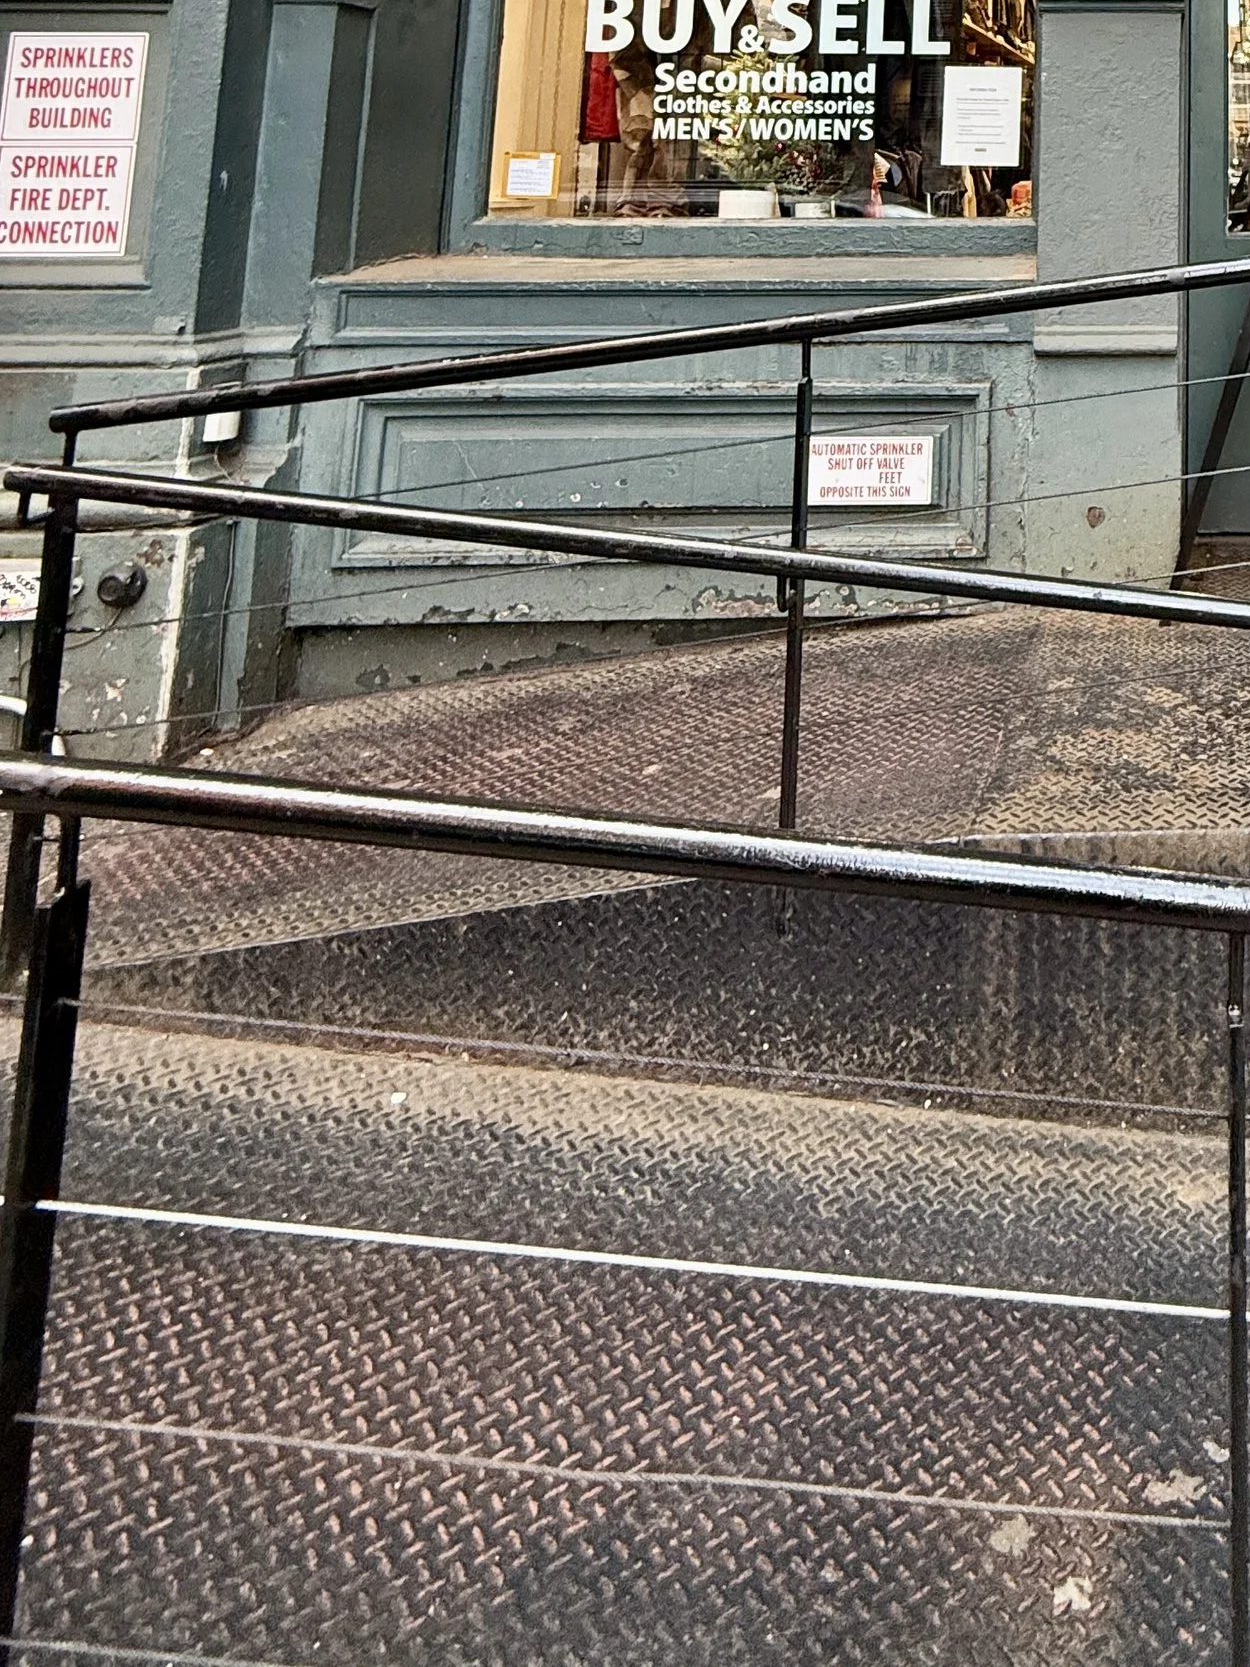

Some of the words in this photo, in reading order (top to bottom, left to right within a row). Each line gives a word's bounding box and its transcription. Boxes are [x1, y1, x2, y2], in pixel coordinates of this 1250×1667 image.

[738, 24, 765, 54] &
[20, 46, 135, 69] SPRINKLERS
[14, 77, 135, 99] THROUGHOUT
[654, 62, 877, 94] Secondhand
[653, 95, 732, 114] Clothes
[735, 95, 752, 114] &
[756, 95, 875, 114] Accessories
[28, 107, 112, 128] BUILDING
[10, 155, 118, 178] SPRINKLER
[9, 188, 53, 211] FIRE
[57, 188, 110, 211] DEPT.
[811, 443, 867, 455] AUTOMATIC
[870, 442, 923, 455] SPRINKLER
[828, 457, 854, 470] SHUT
[856, 457, 875, 470] OFF
[877, 457, 905, 470] VALVE
[879, 471, 902, 483] FEET
[819, 486, 864, 498] OPPOSITE
[867, 486, 887, 497] THIS
[889, 486, 911, 497] SIGN
